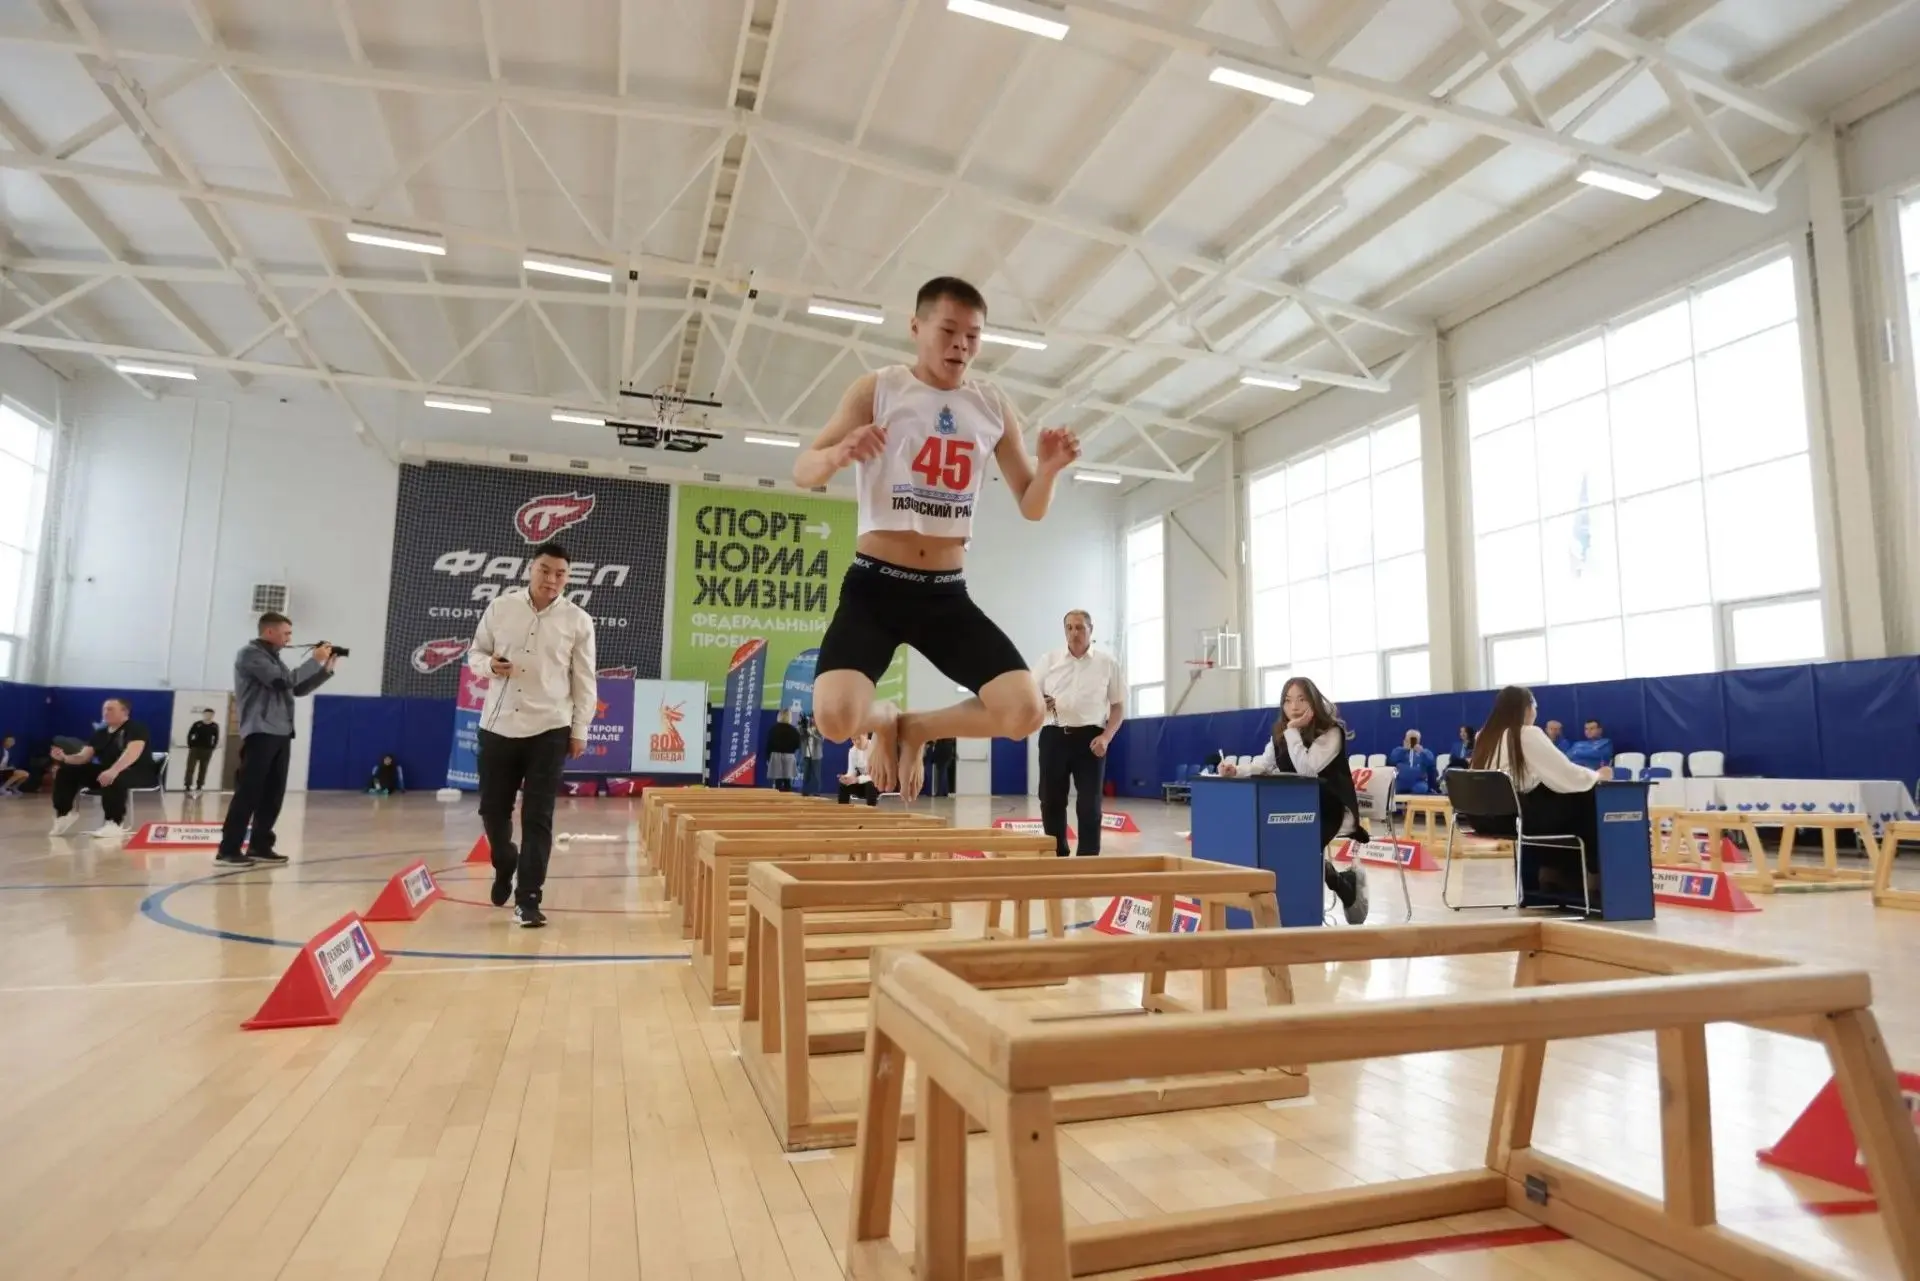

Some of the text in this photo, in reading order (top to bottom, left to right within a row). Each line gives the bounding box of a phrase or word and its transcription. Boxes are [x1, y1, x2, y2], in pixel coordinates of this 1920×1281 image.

[912, 436, 975, 491] 45
[695, 506, 807, 543] СПОРТ
[433, 548, 630, 587] ФАЕЛ
[694, 540, 829, 579] НОРМА
[879, 566, 928, 583] DEMIX
[692, 575, 828, 613] ЖИЗНИ
[692, 612, 829, 633] ФЕДЕРАЛЬНЫЙ
[570, 783, 579, 794] 2
